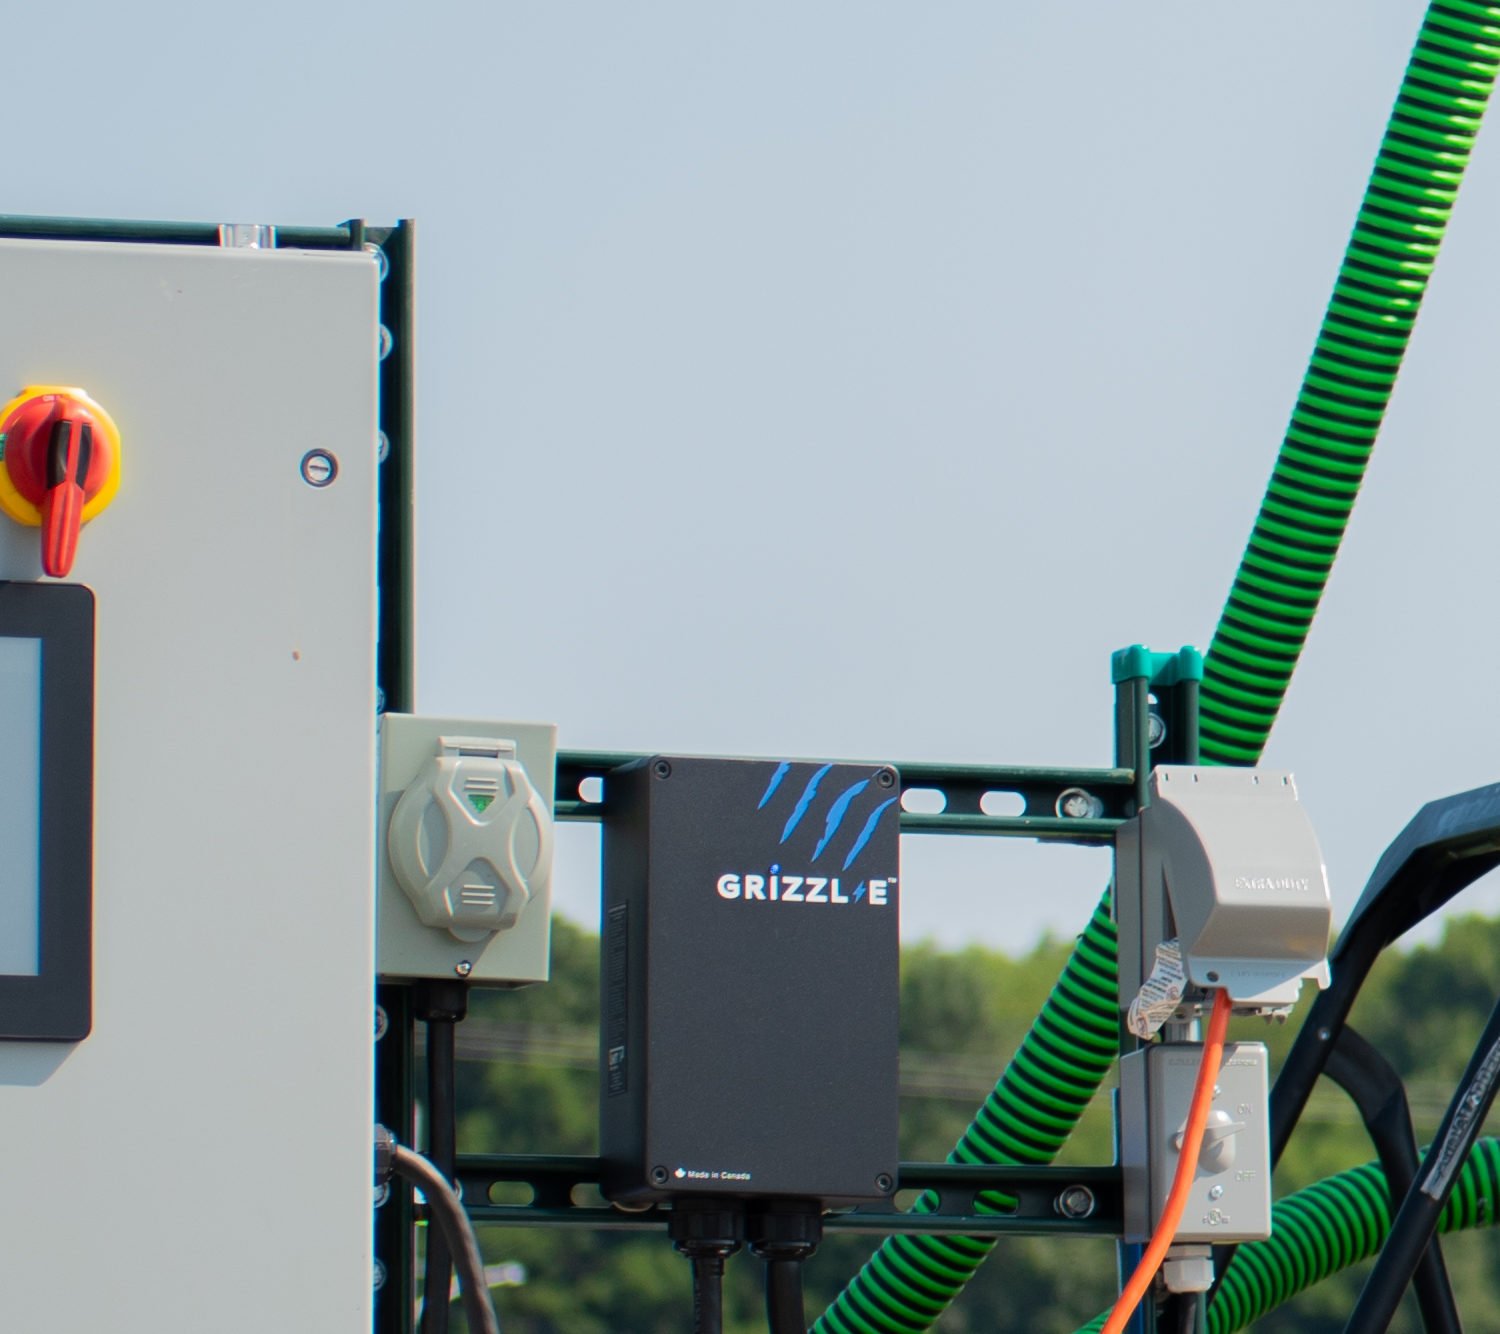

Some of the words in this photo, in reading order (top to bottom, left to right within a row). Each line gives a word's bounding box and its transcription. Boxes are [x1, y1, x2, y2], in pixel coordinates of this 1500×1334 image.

[688, 1170, 710, 1179] Made
[721, 1171, 751, 1180] Canada
[1234, 1170, 1256, 1182] OFF
